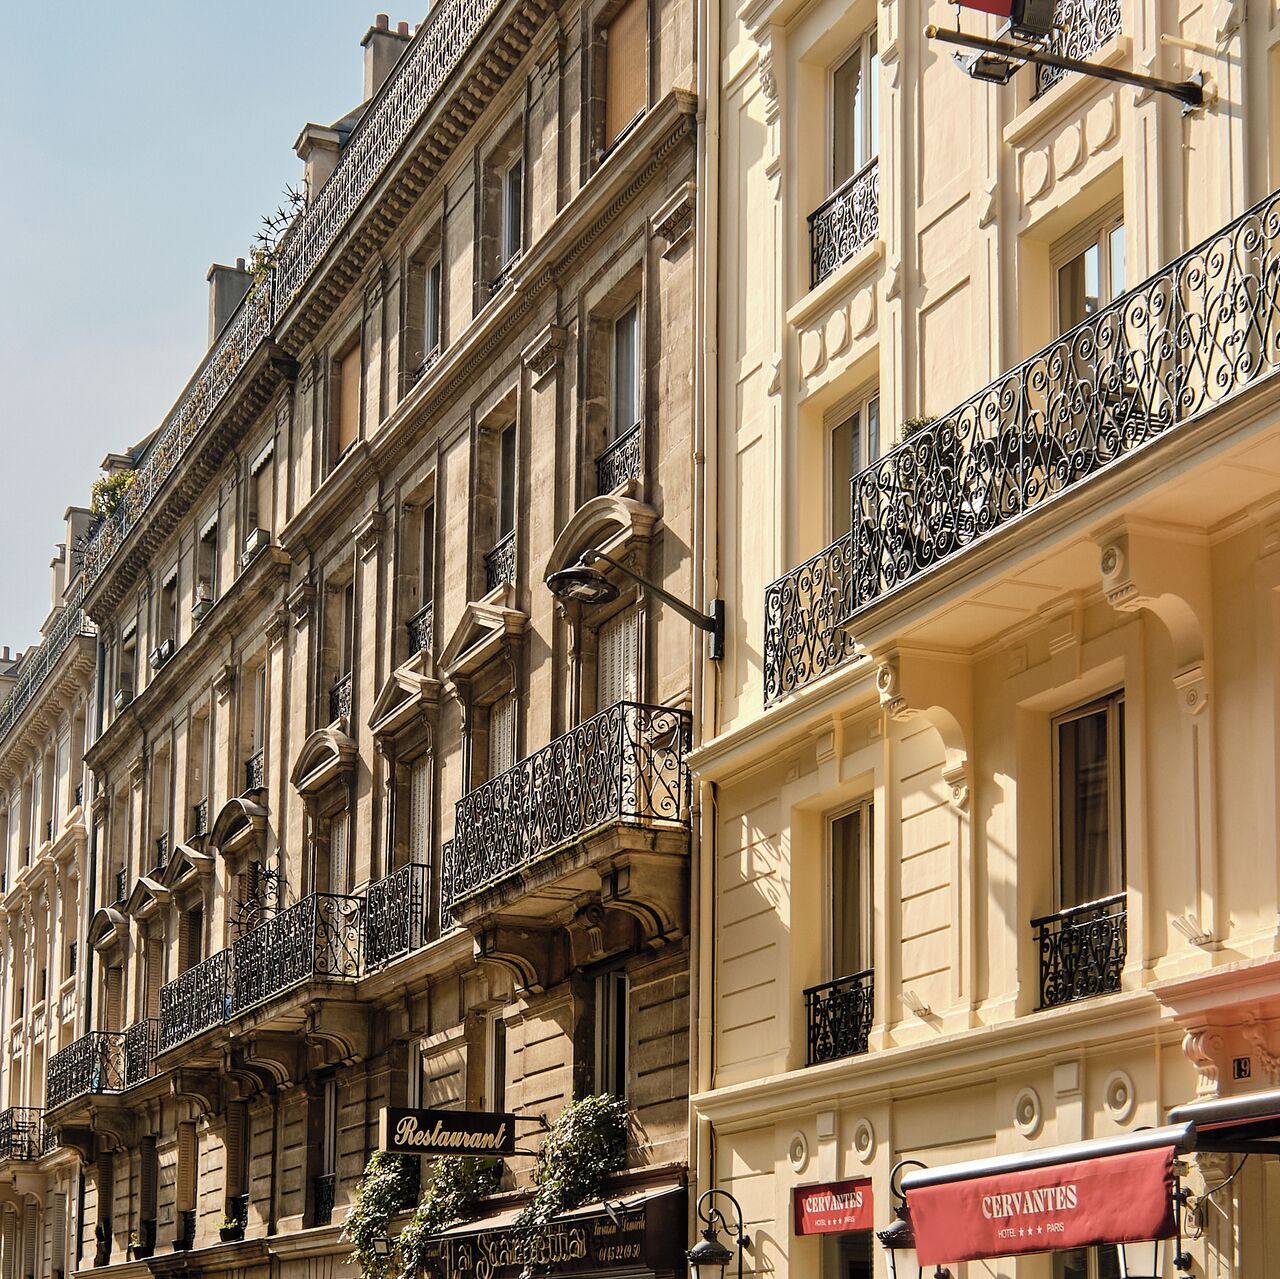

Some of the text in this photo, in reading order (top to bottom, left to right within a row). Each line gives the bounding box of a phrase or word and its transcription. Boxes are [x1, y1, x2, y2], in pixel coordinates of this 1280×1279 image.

[1234, 1058, 1250, 1078] 19
[394, 1116, 507, 1149] Restaurant
[806, 1191, 863, 1213] CERVANTES
[982, 1184, 1078, 1220] CERVANTES
[998, 1222, 1065, 1239] HOTEL PARIS
